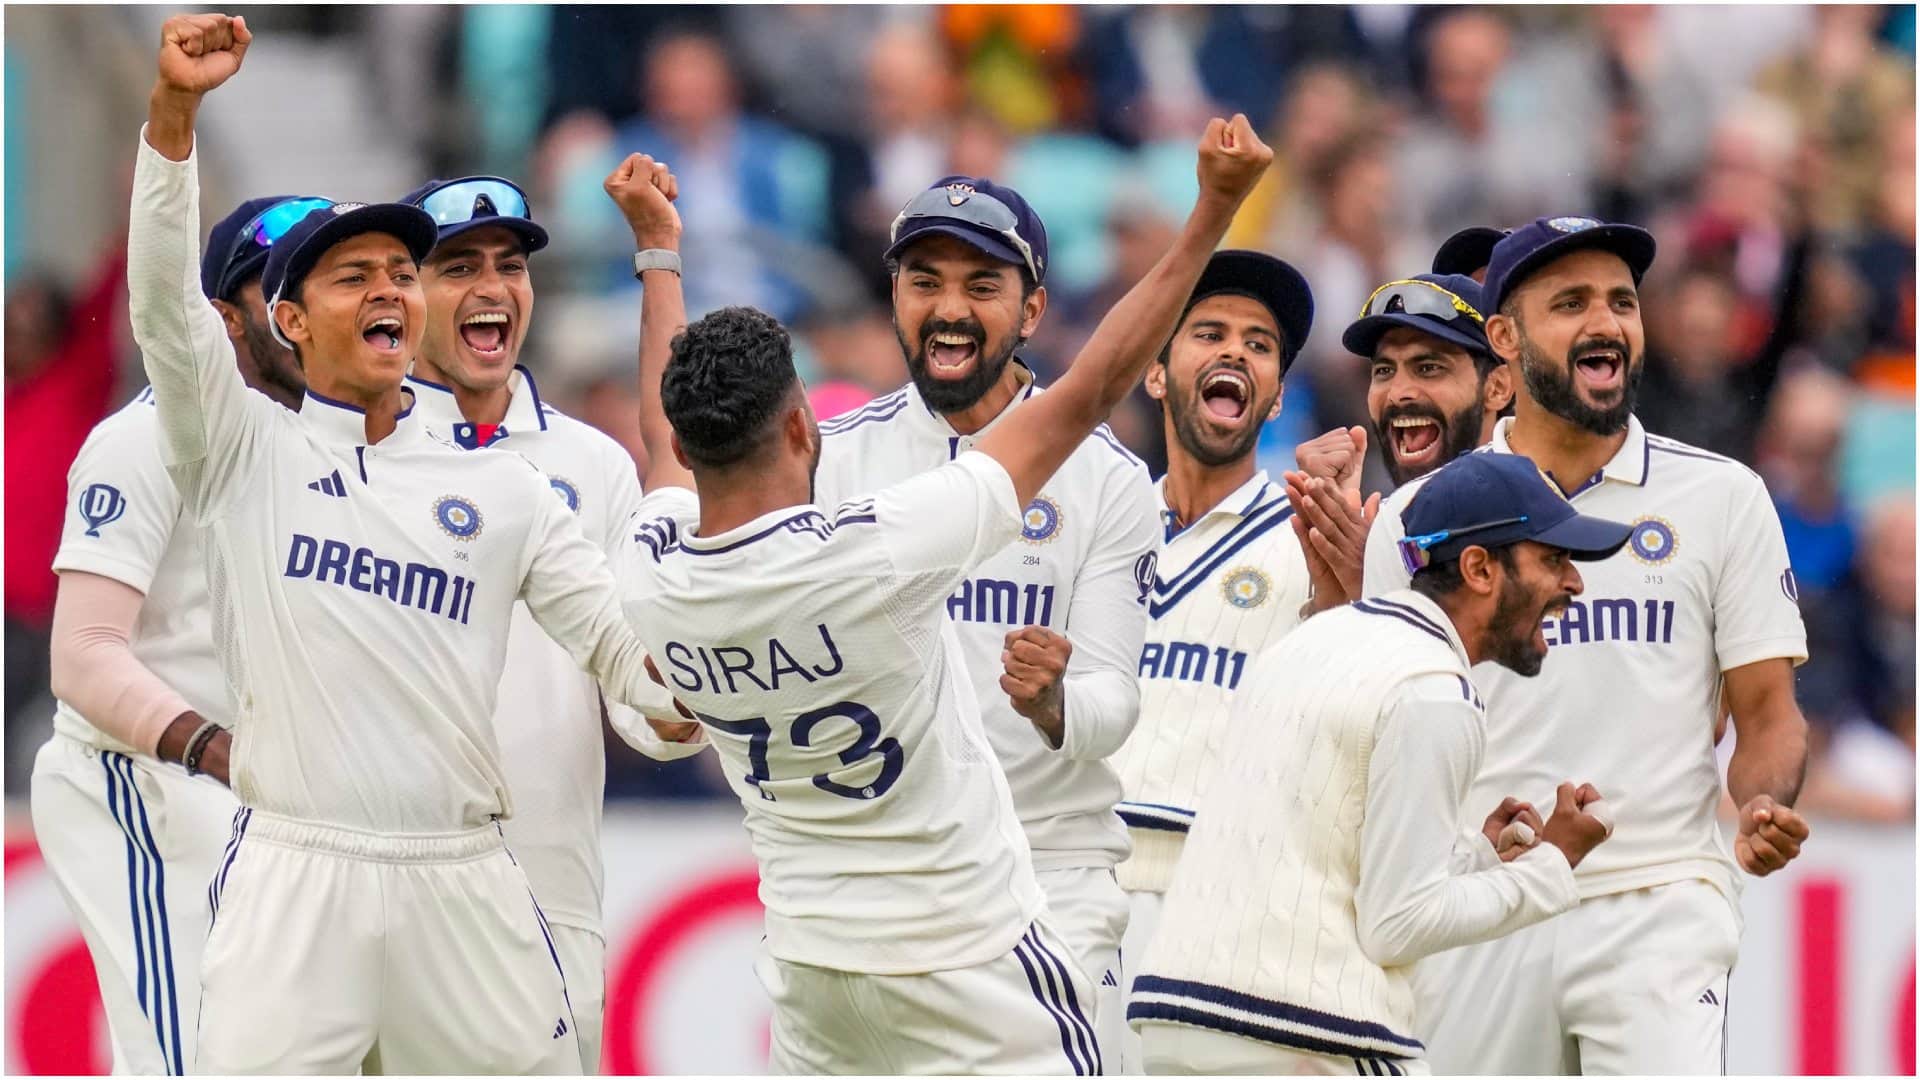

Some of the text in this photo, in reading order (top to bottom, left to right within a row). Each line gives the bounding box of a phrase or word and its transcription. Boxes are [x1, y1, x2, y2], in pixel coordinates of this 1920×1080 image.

[284, 533, 476, 626] DREAM11
[453, 550, 470, 562] 306
[1023, 554, 1041, 567] 284
[1644, 574, 1664, 585] 313
[665, 623, 844, 695] SIRAJ
[1138, 641, 1248, 691] AM11
[692, 700, 904, 803] 73
